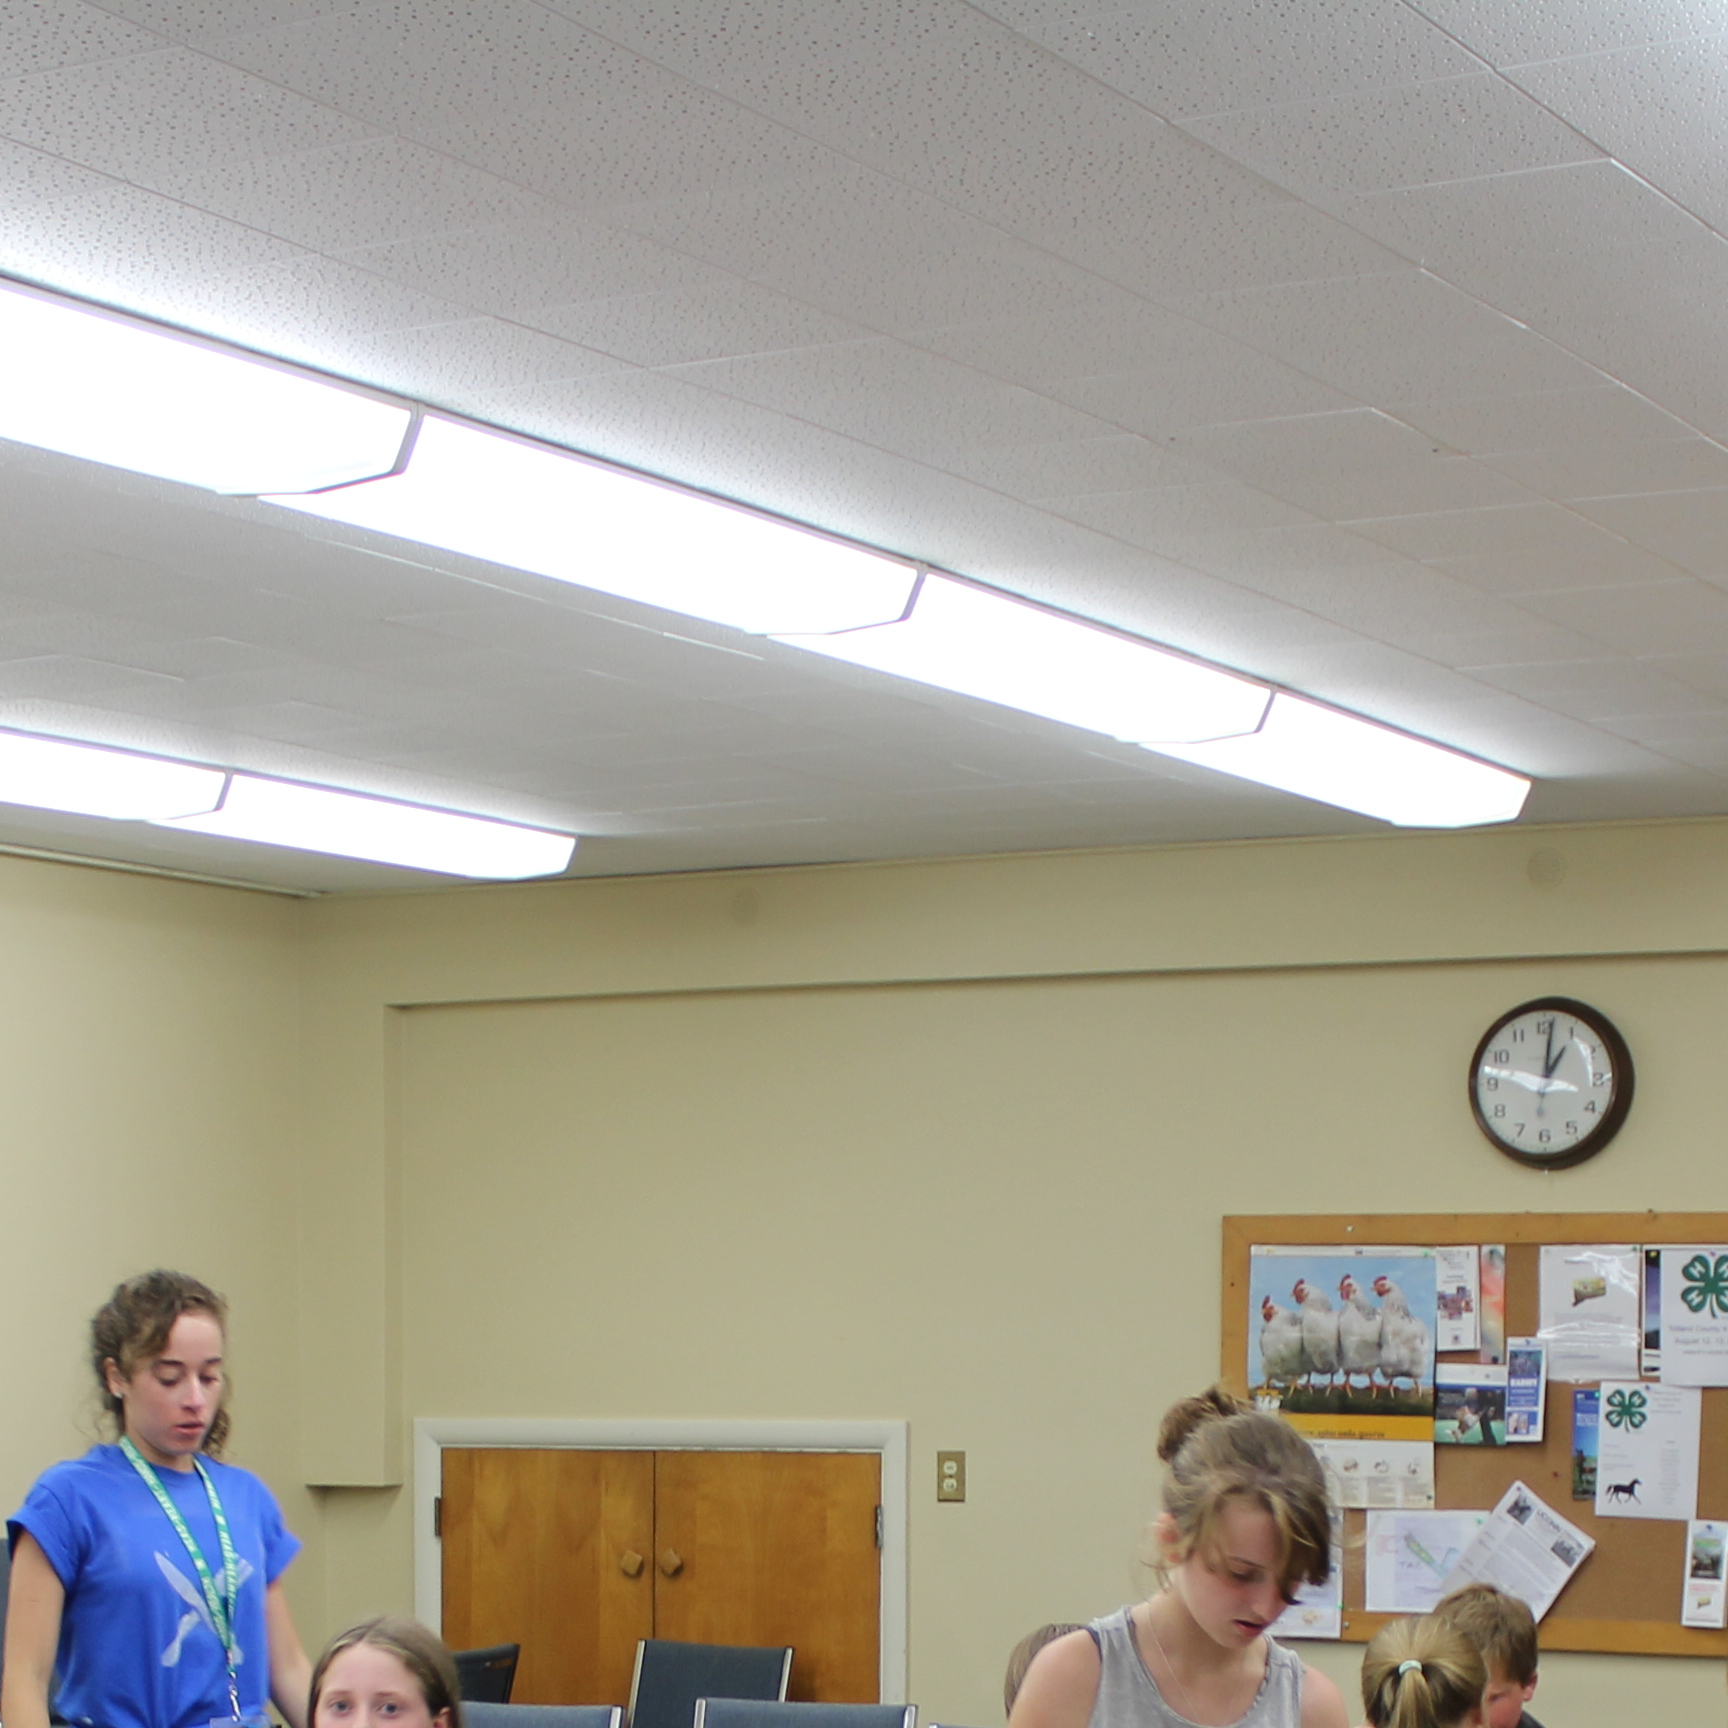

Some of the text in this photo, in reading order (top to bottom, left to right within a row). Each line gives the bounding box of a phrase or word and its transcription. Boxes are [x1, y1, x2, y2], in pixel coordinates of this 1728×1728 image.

[1536, 1021, 1554, 1036] 12
[1512, 1029, 1525, 1043] 11
[1493, 1050, 1510, 1064] 10
[1487, 1077, 1499, 1092] 9
[1494, 1104, 1506, 1118] 8
[1584, 1100, 1597, 1114] 4
[1514, 1123, 1526, 1137] 7
[1565, 1121, 1578, 1135] 5
[1538, 1128, 1551, 1143] 6
[1688, 1261, 1706, 1279] H
[1686, 1289, 1704, 1306] H
